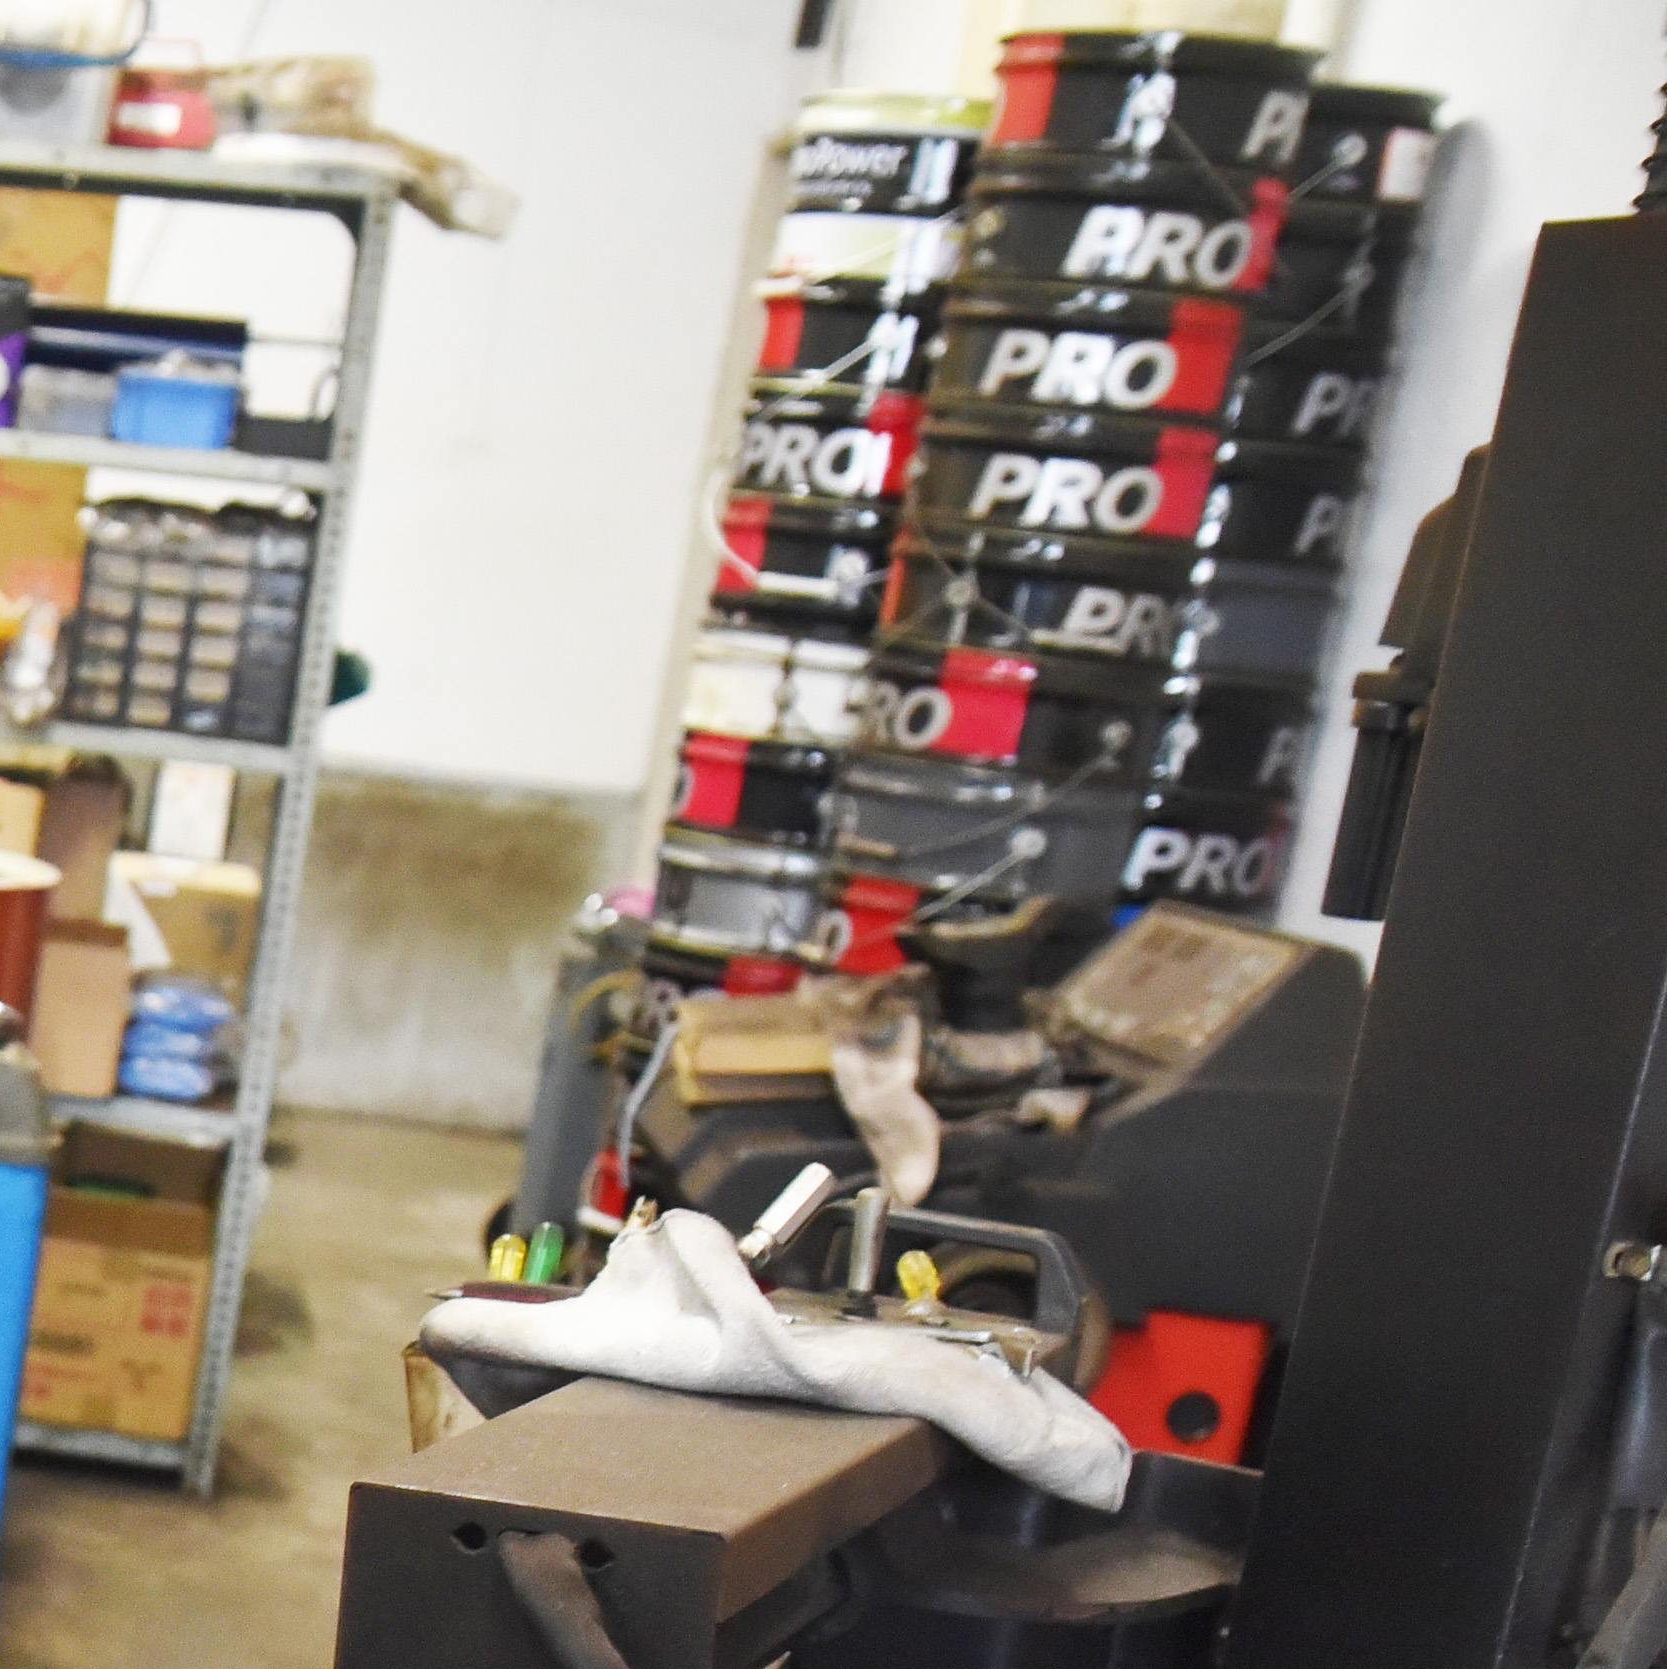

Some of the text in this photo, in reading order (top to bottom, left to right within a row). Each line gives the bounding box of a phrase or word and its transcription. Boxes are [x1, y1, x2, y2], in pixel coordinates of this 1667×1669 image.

[1060, 204, 1253, 290] PRO
[978, 329, 1178, 410] PRO
[736, 421, 871, 497] PRO
[968, 453, 1164, 534] PRO
